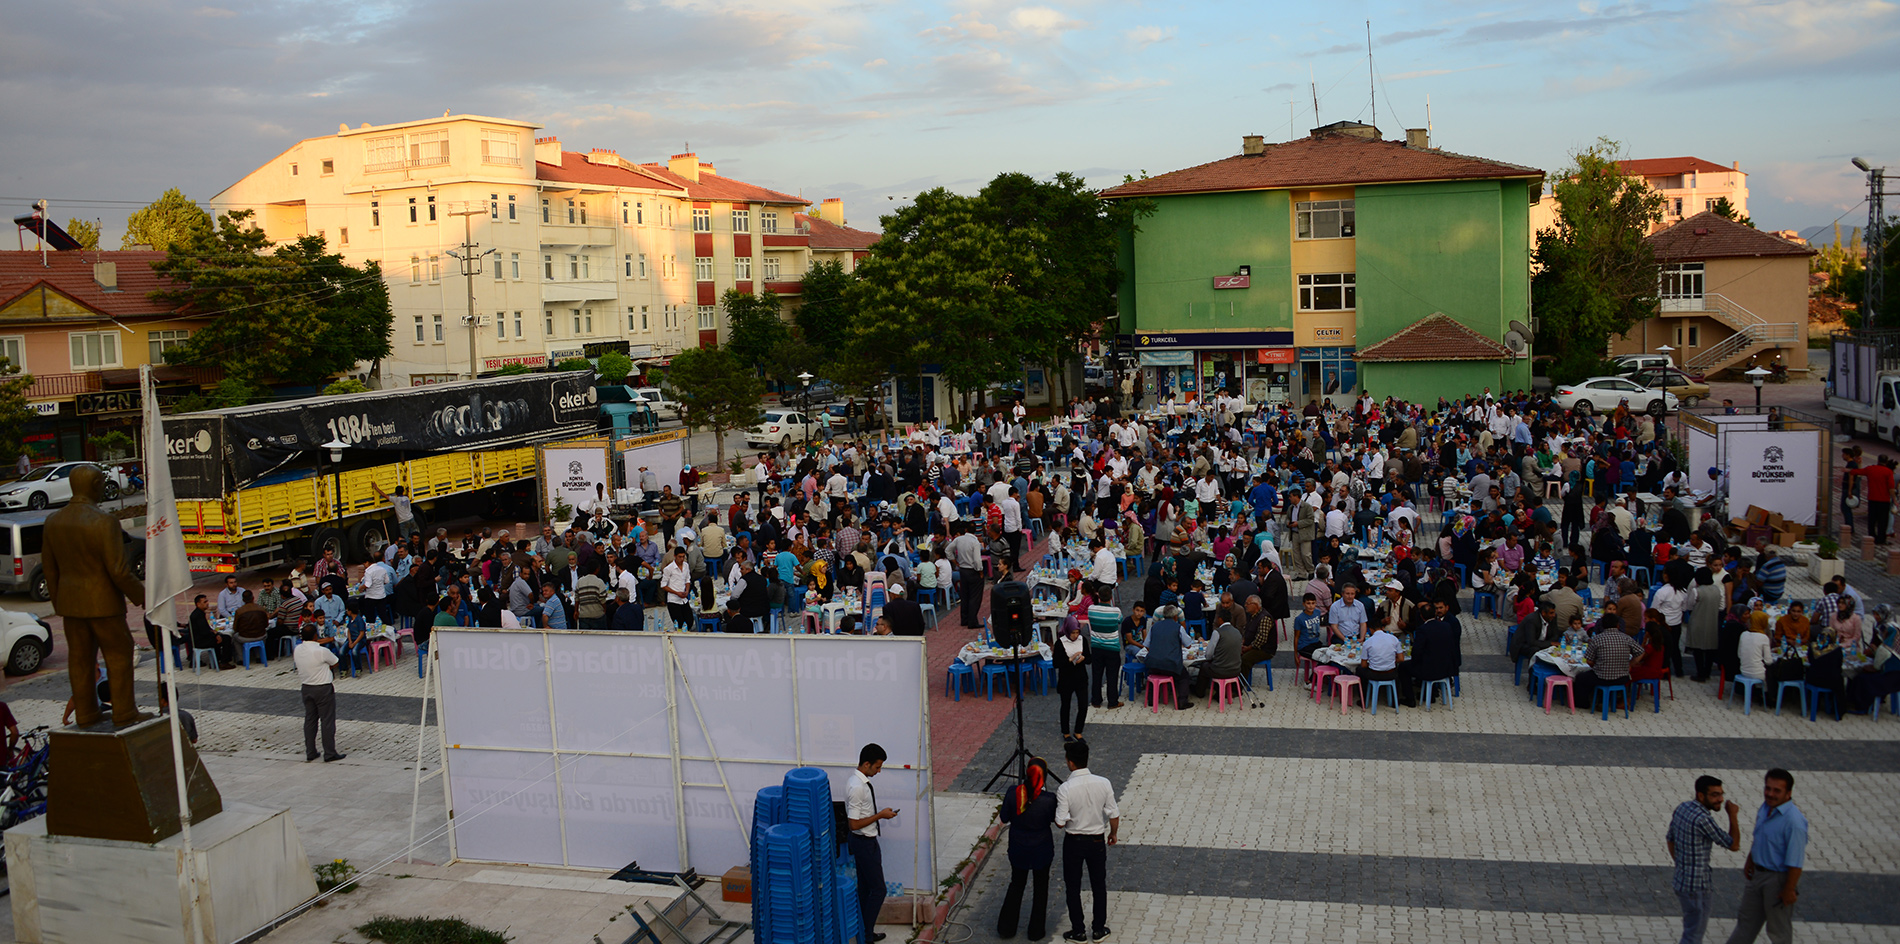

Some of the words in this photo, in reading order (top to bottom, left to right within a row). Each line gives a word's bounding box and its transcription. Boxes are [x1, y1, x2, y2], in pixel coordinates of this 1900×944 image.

[485, 358, 502, 370] YEŞİL
[522, 355, 545, 365] MARKET
[79, 393, 131, 413] ÖZEN
[559, 391, 587, 409] eker
[381, 421, 396, 435] beri
[164, 433, 194, 455] ker
[1752, 469, 1795, 479] BÜYÜKŞEHİR
[562, 480, 592, 488] BÜYÜKŞEHİR
